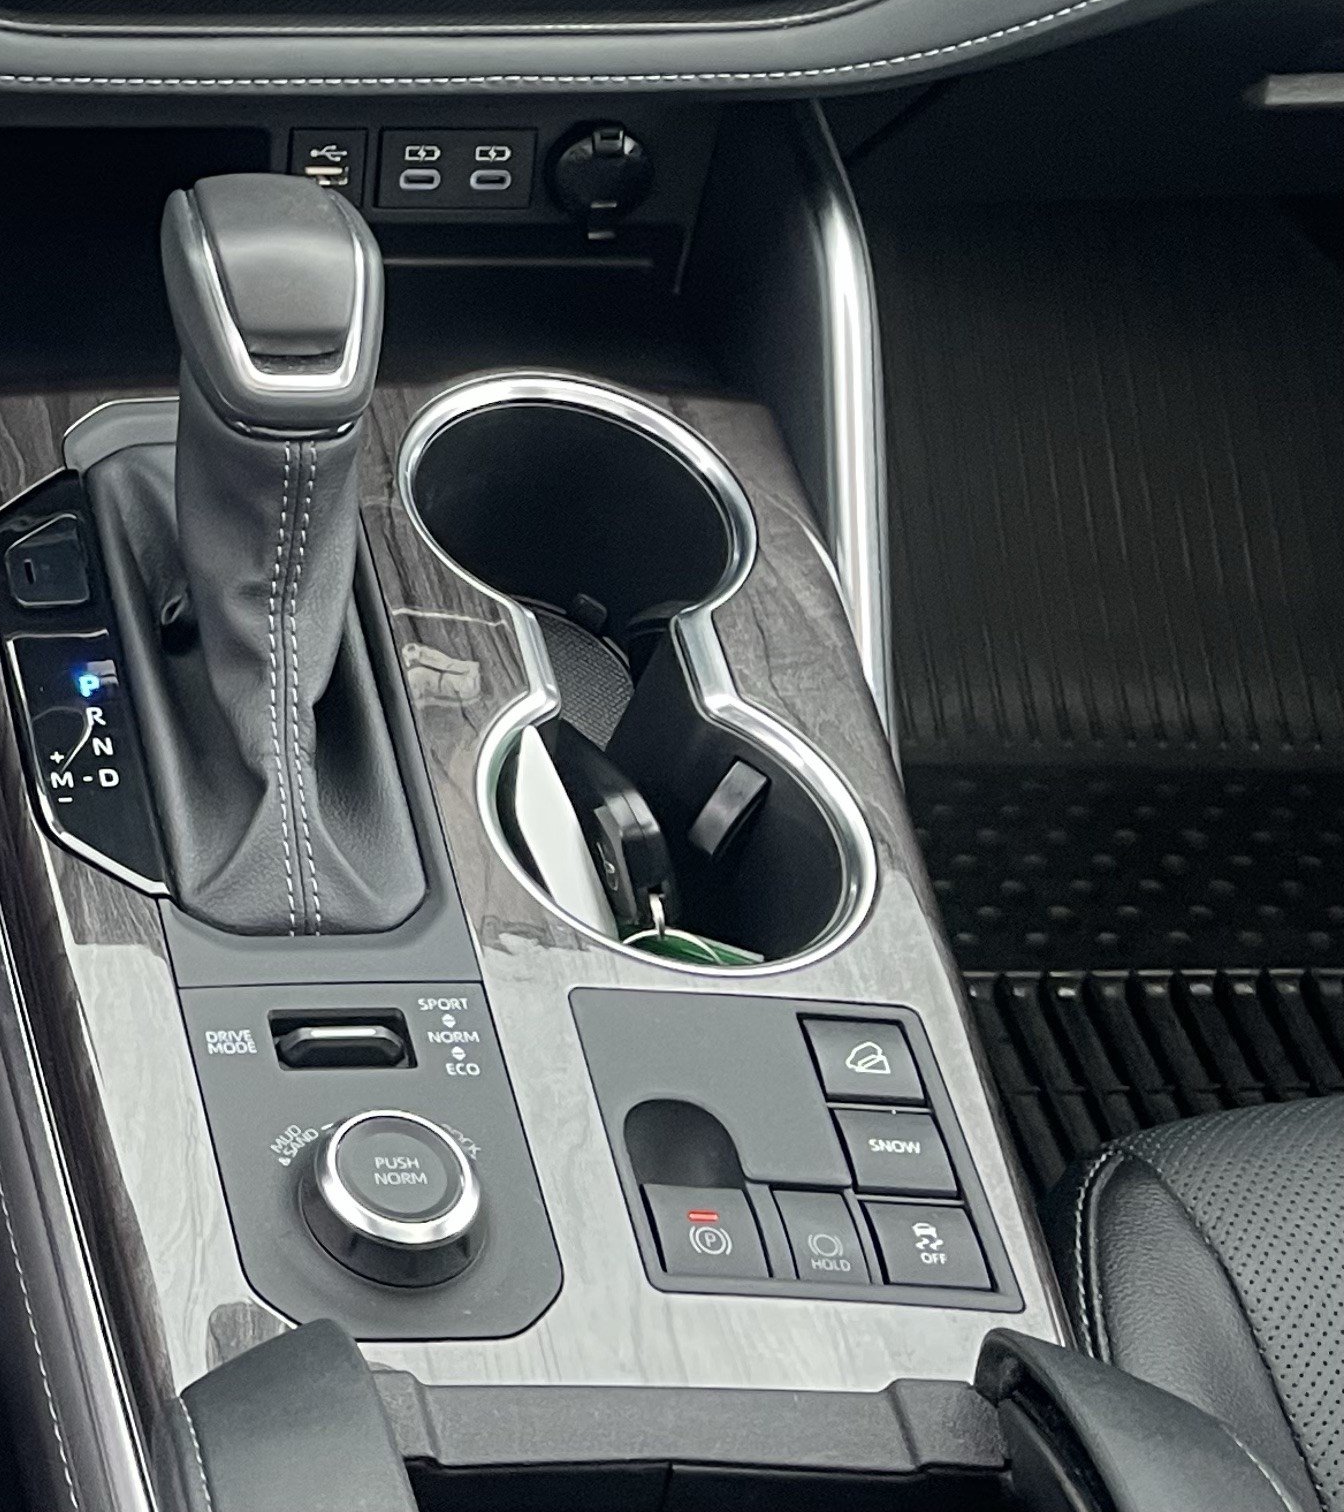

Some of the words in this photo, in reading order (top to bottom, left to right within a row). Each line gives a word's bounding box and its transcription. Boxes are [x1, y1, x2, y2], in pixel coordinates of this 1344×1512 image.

[78, 675, 100, 697] P
[85, 707, 107, 727] R
[92, 737, 114, 757] N
[50, 772, 74, 789] M
[98, 768, 119, 788] D
[418, 997, 468, 1012] SPORT
[205, 1029, 252, 1042] DRIVE
[427, 1031, 480, 1044] NORM
[207, 1041, 257, 1055] MODE
[445, 1062, 481, 1076] ECO
[270, 1124, 303, 1154] MUD
[283, 1127, 319, 1159] SAND
[868, 1138, 922, 1155] SNOW
[374, 1156, 420, 1170] PUSH
[373, 1171, 429, 1186] NORM
[811, 1258, 852, 1272] HOLD
[920, 1252, 947, 1265] OFF
